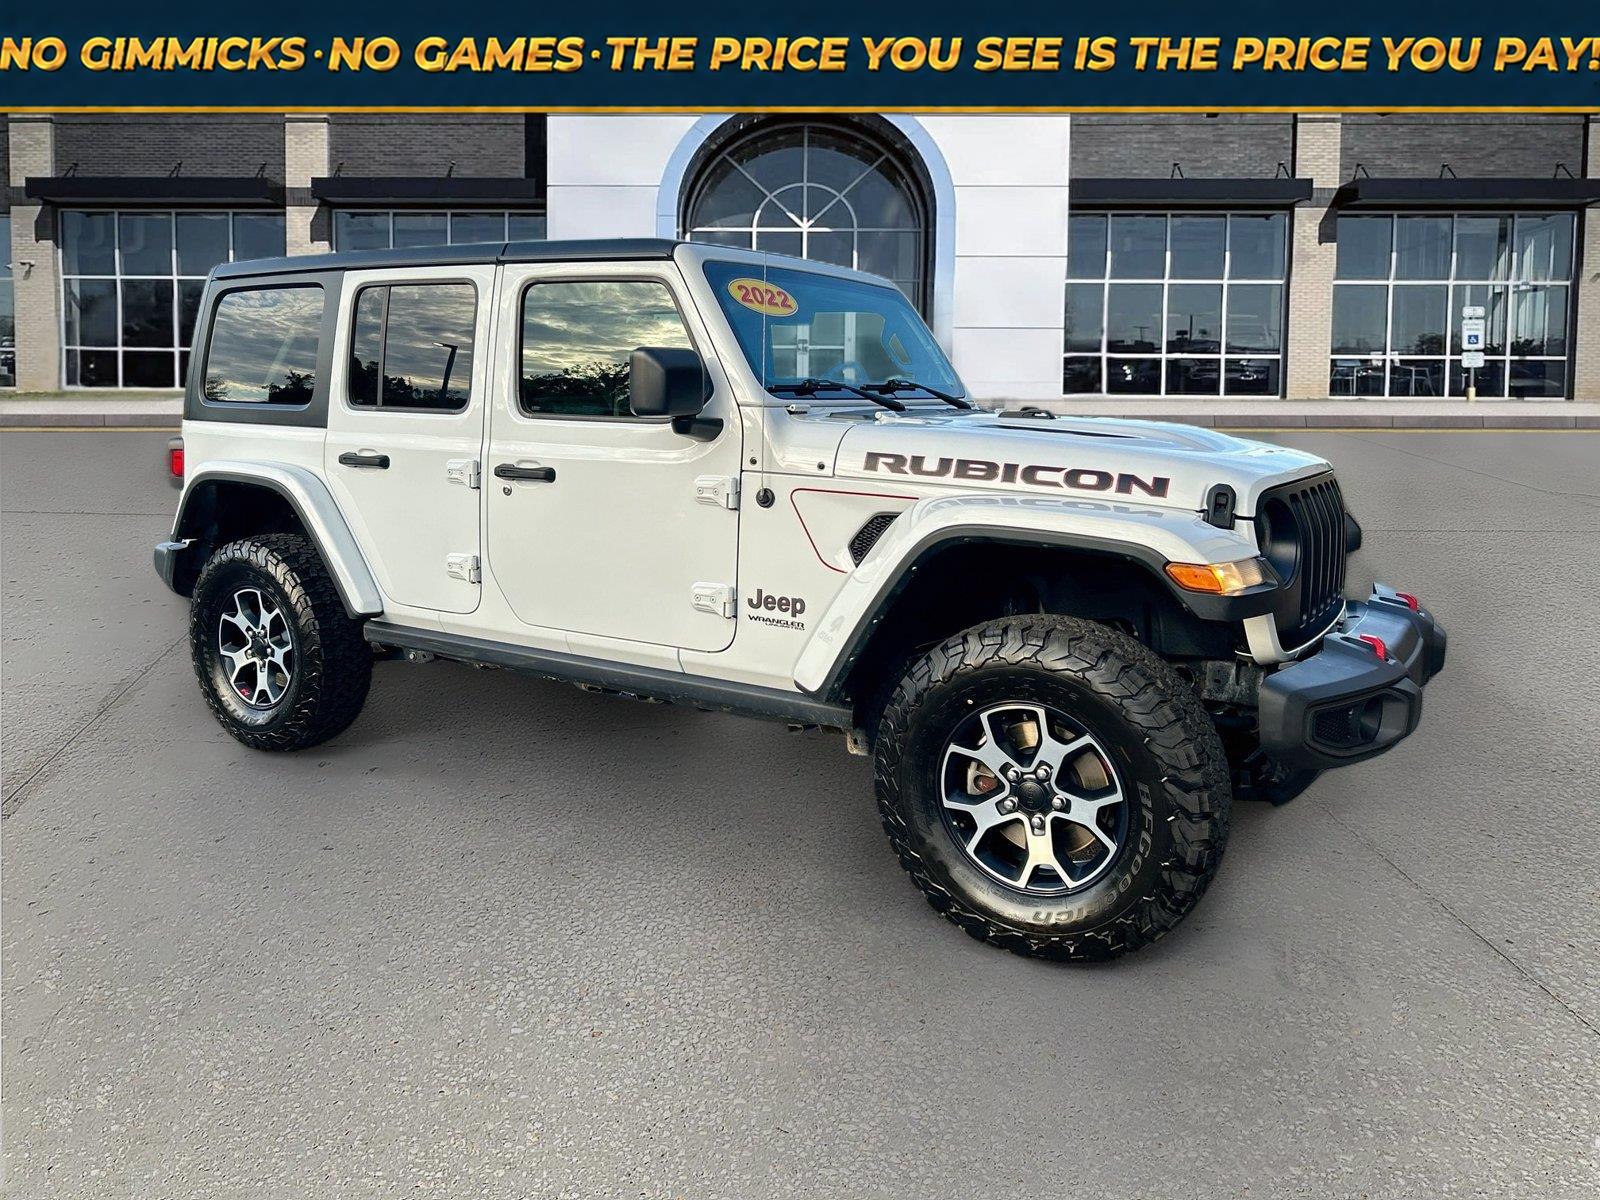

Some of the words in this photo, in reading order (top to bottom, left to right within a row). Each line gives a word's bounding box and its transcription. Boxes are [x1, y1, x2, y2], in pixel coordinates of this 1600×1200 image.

[737, 284, 792, 309] 2022
[863, 452, 1170, 498] RUBICON
[747, 588, 806, 618] Jeep
[748, 614, 805, 629] WRANGLER
